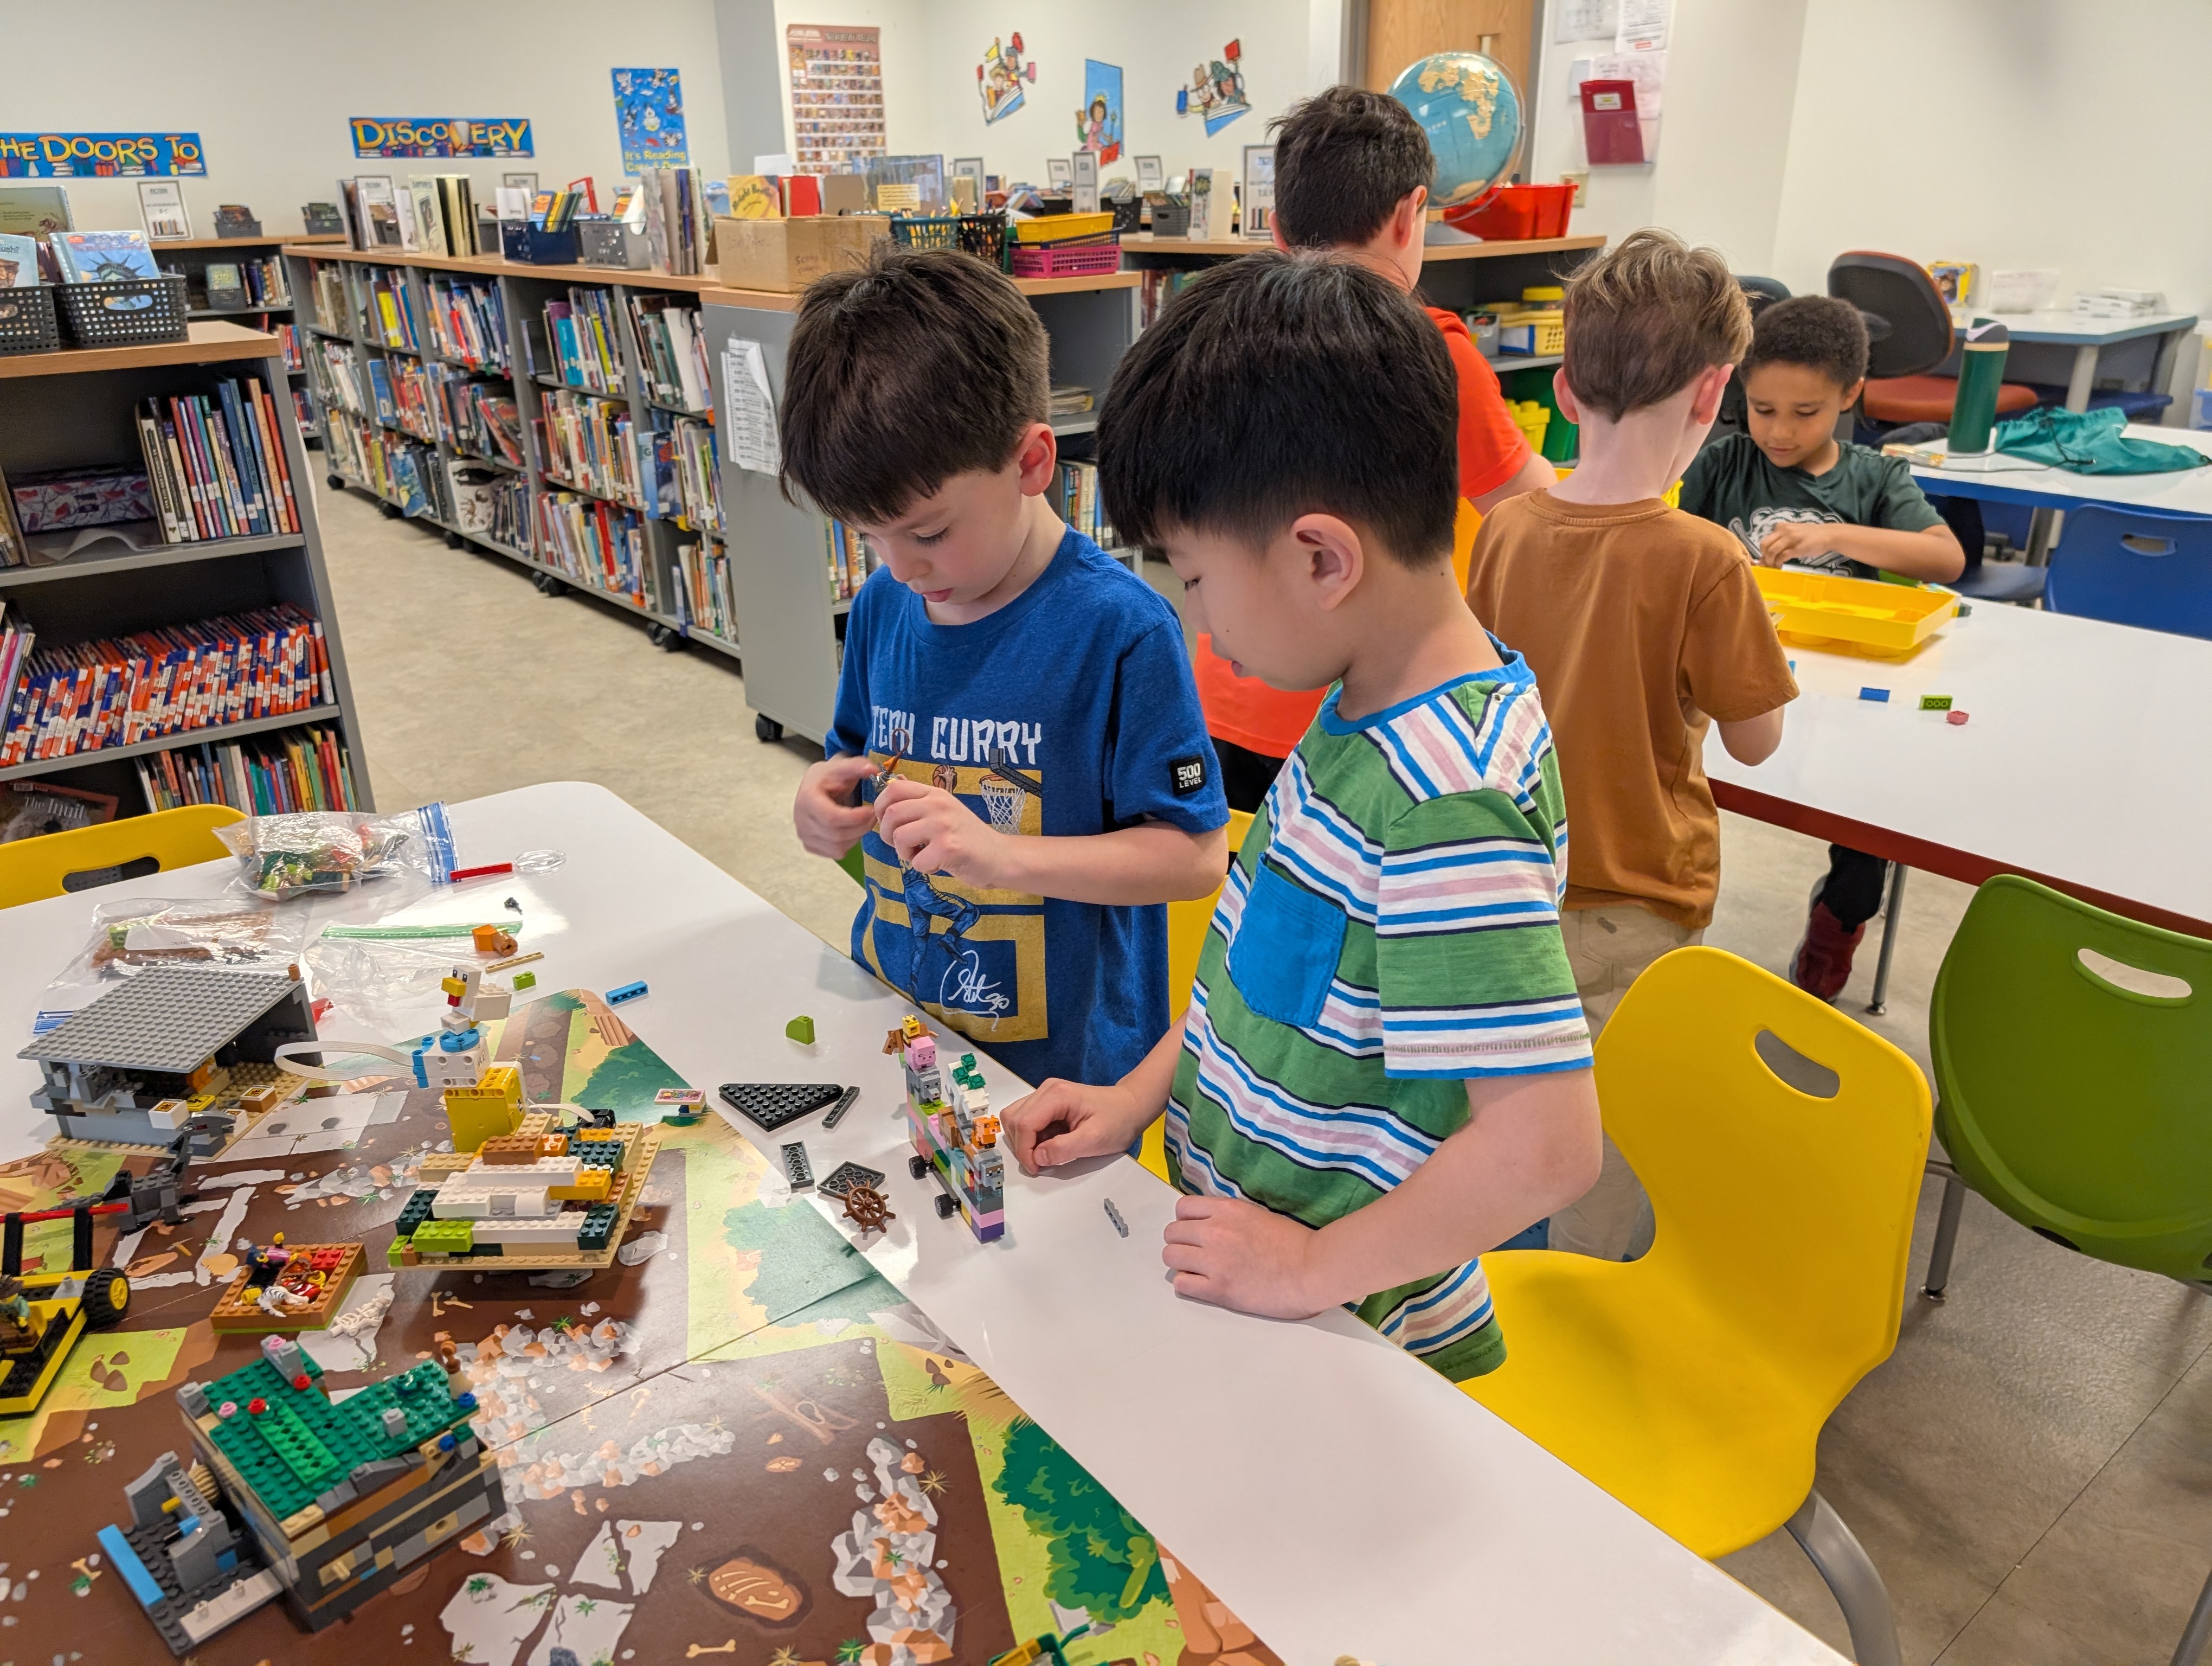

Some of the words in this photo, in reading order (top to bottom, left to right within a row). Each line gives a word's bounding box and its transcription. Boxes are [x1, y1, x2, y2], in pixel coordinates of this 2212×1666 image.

[352, 119, 529, 151] DISCOVERY
[0, 137, 39, 161] HE
[38, 135, 158, 164] DOORS
[644, 150, 686, 161] Reading
[0, 245, 20, 254] uch?
[871, 705, 915, 755] TEPH
[931, 716, 1041, 766] CURRY
[1177, 762, 1201, 781] 500
[1179, 777, 1203, 789] LEVEL
[25, 797, 45, 810] The
[48, 798, 85, 819] Inuit
